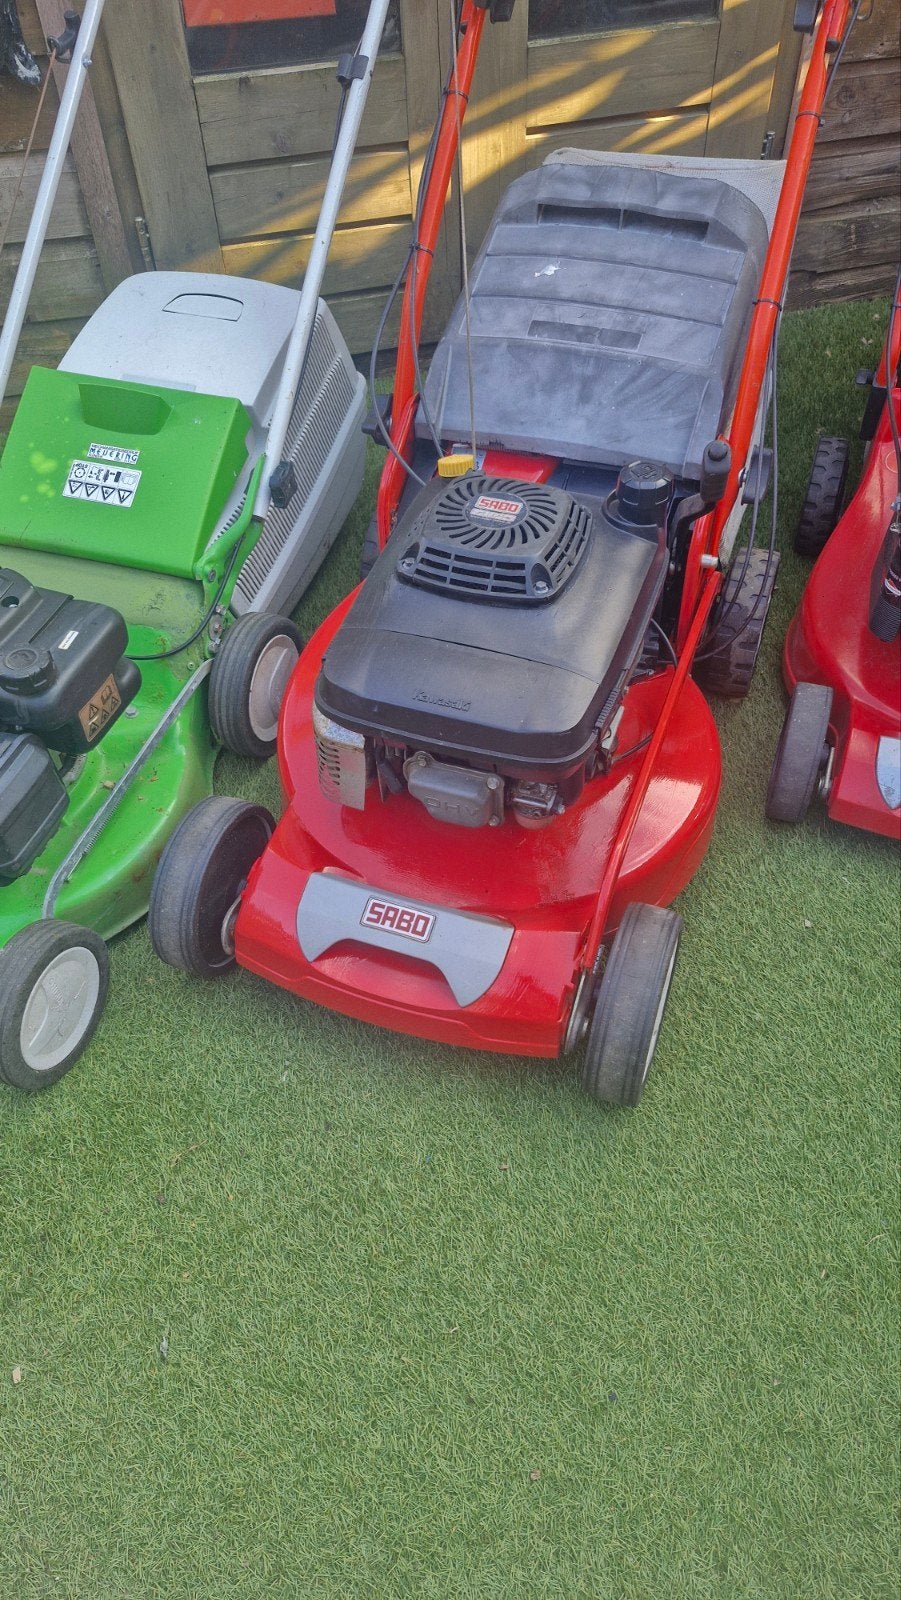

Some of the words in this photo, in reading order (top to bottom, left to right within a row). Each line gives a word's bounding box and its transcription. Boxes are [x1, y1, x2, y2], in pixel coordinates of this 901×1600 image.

[479, 499, 519, 513] SABO
[412, 690, 473, 711] Kawasaki
[366, 903, 430, 937] SABO
